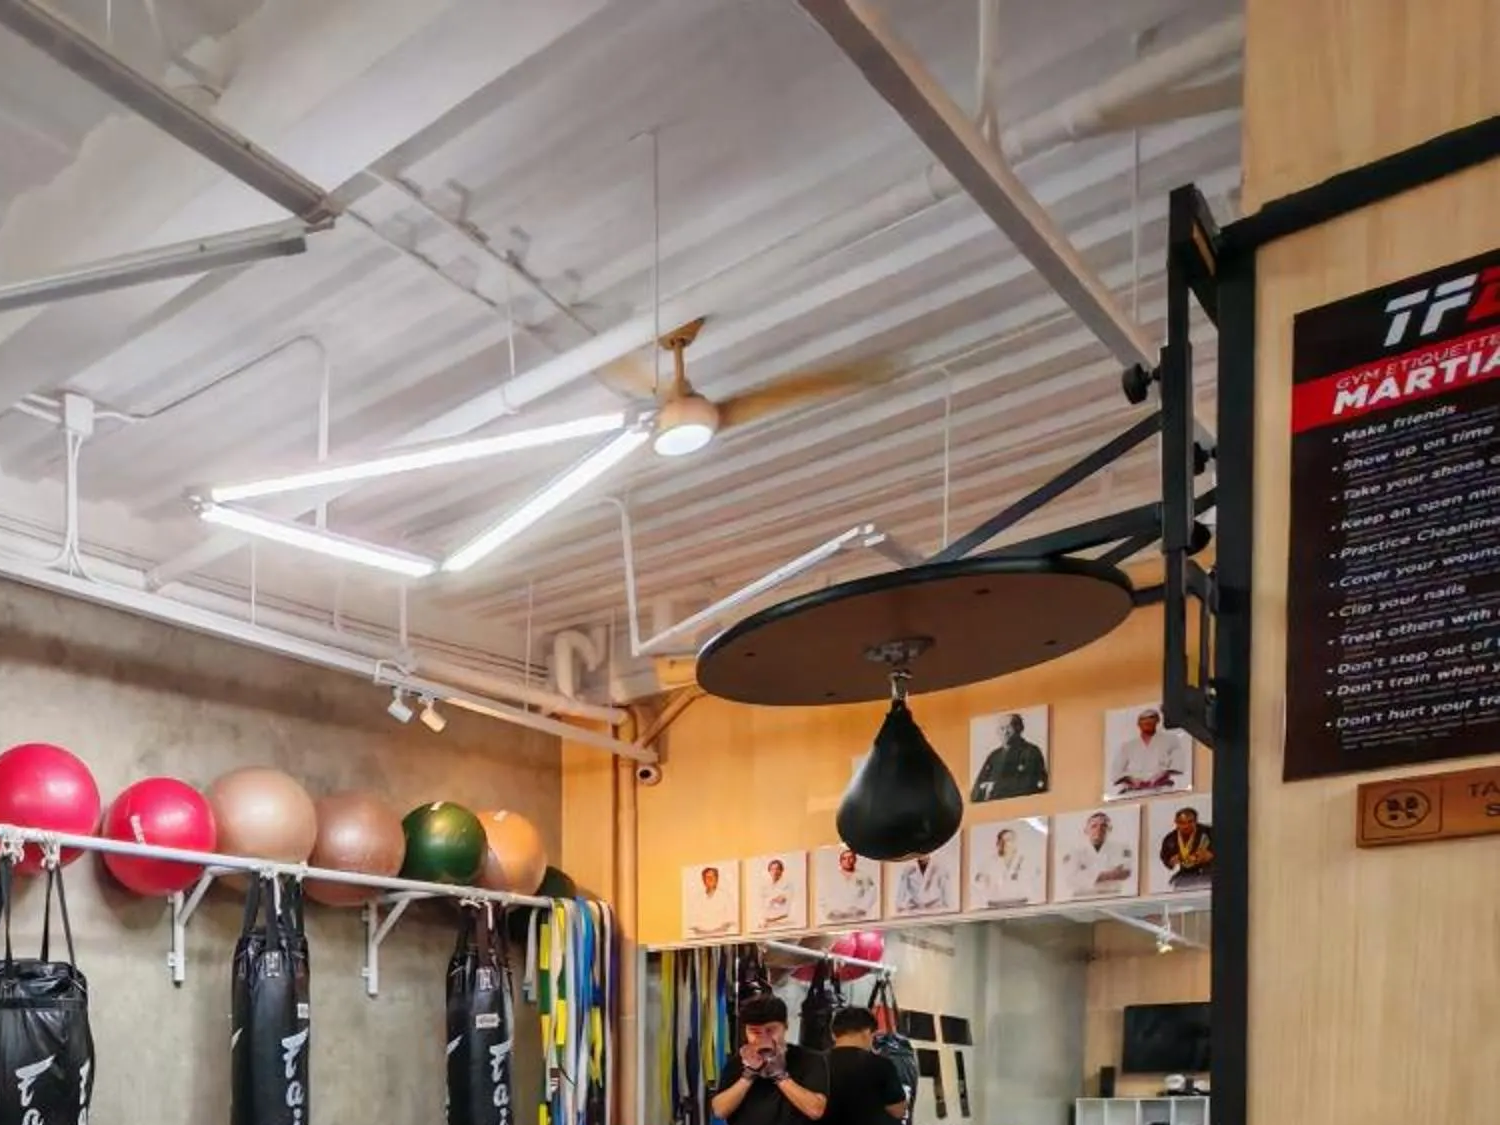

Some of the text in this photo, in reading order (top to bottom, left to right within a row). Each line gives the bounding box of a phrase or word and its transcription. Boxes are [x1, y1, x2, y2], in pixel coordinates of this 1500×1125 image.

[1342, 423, 1388, 443] Make
[1393, 404, 1457, 430] friends
[1342, 425, 1495, 471] Show up on time
[1343, 484, 1382, 500] Take
[1385, 473, 1428, 493] your
[1431, 458, 1486, 480] shoes
[1341, 513, 1386, 531] Keep
[1389, 506, 1412, 520] an
[1416, 494, 1464, 514] open
[1339, 536, 1412, 559] Practice
[1339, 569, 1391, 588] Cover
[1395, 559, 1437, 578] your
[1338, 602, 1374, 618] Clip
[1377, 594, 1419, 611] your
[1423, 583, 1467, 601] nails
[1339, 629, 1383, 646] Treat
[1387, 618, 1446, 637] others
[1450, 608, 1492, 625] with
[1389, 650, 1429, 665] step
[1433, 642, 1465, 657] out
[1471, 637, 1494, 651] of
[1389, 673, 1431, 688] train
[1436, 663, 1487, 681] when
[1387, 705, 1427, 721] hurt
[1431, 698, 1474, 715] your
